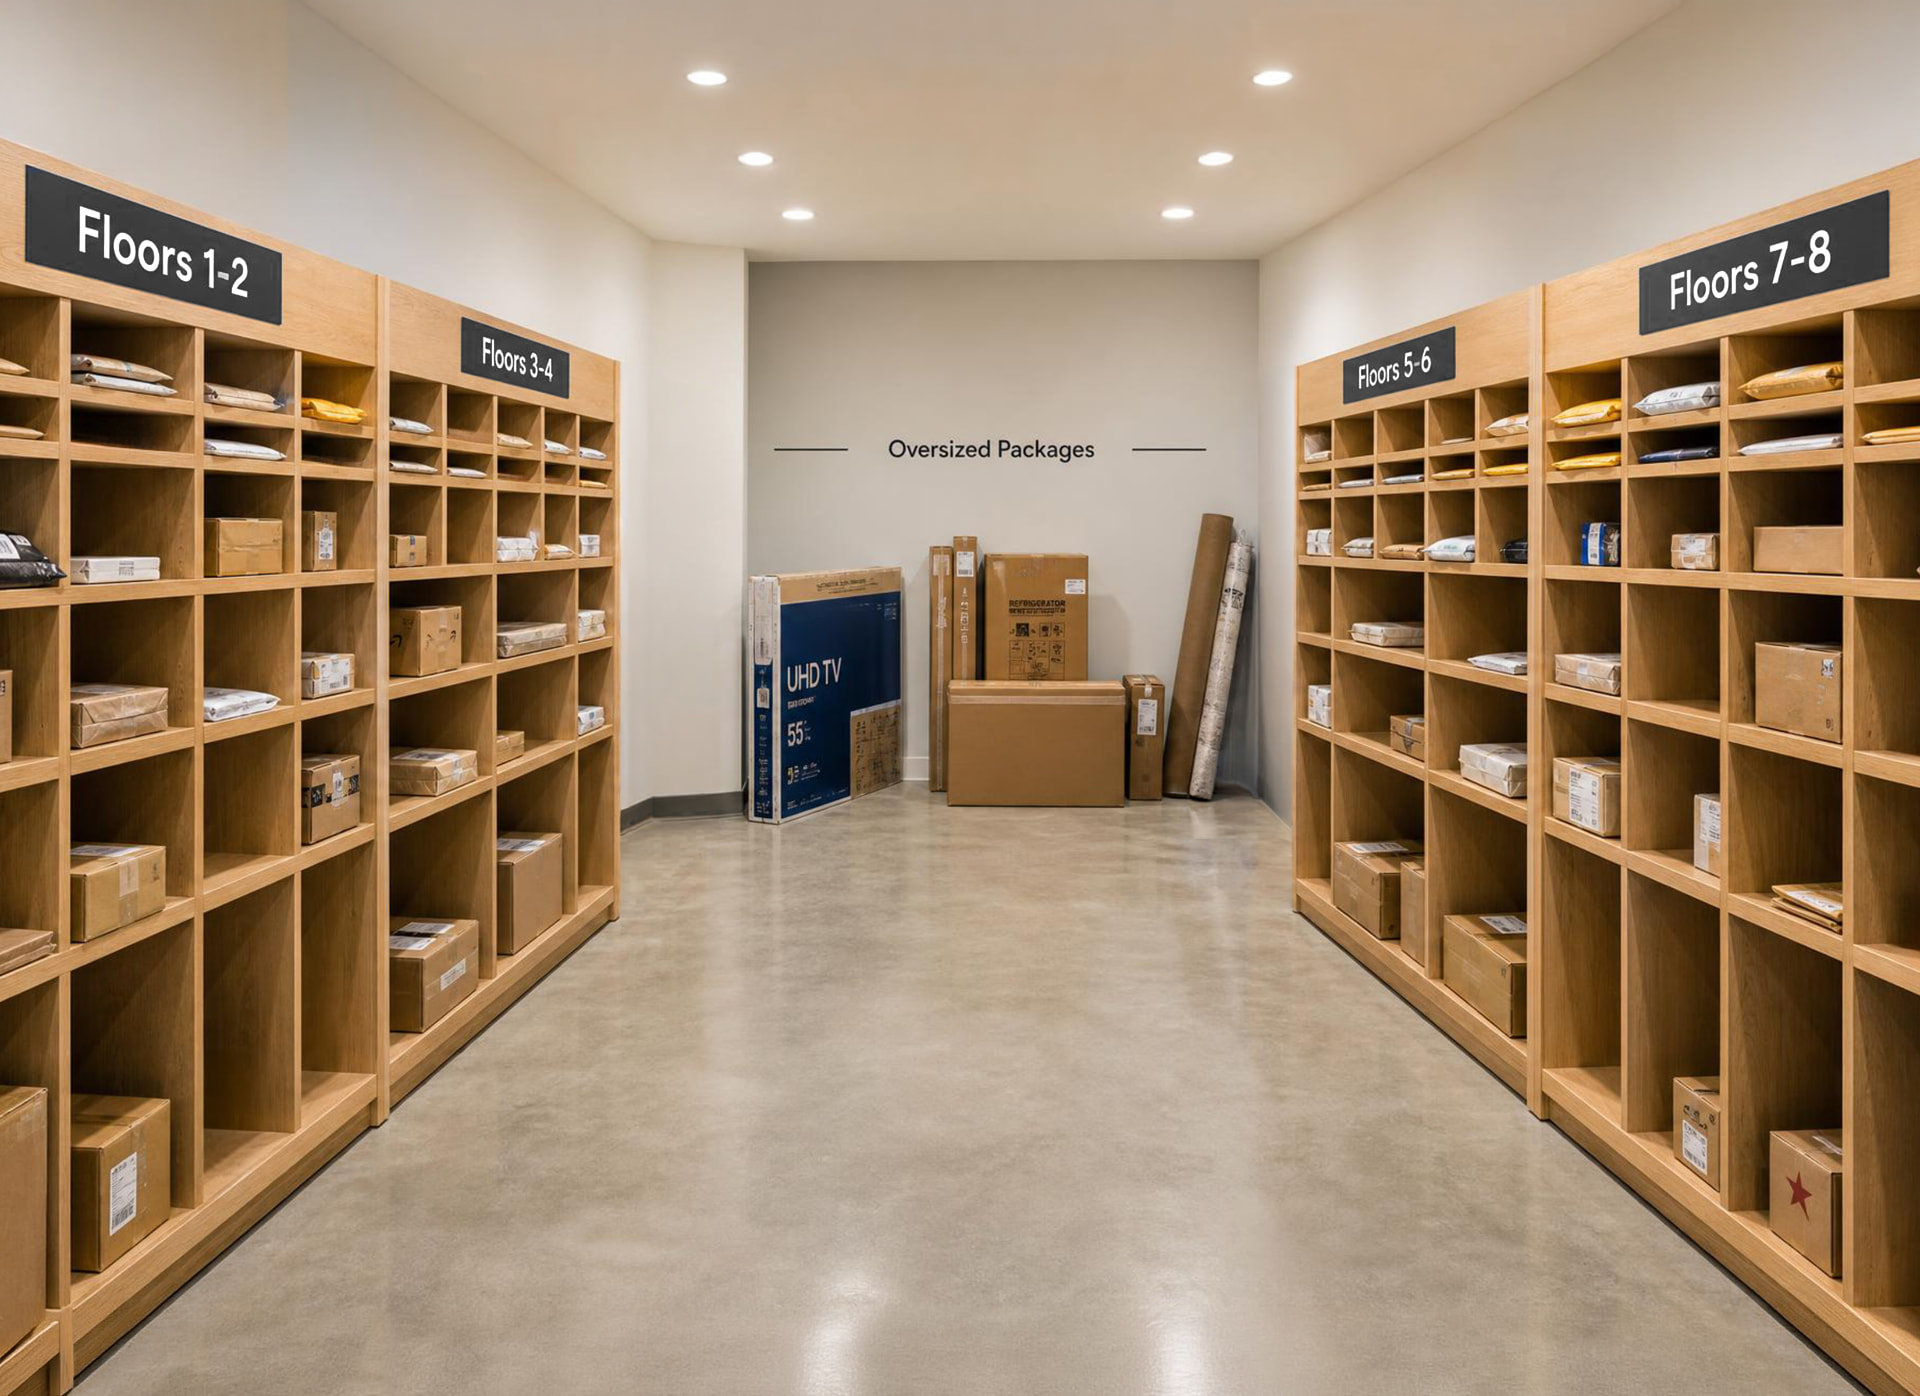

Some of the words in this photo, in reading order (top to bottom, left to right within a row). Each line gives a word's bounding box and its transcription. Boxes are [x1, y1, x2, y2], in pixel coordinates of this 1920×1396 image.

[79, 206, 192, 282] Floors
[203, 249, 248, 297] 1-2
[1670, 262, 1759, 310] Floors
[1769, 230, 1832, 285] 7-8
[482, 337, 527, 376] Floors
[530, 353, 554, 382] 3-4
[1358, 362, 1400, 389] Floors
[1404, 346, 1432, 378] 5-6
[888, 439, 990, 458] Oversized
[998, 439, 1095, 463] Packages
[787, 662, 820, 692] UHD
[822, 657, 842, 685] TV
